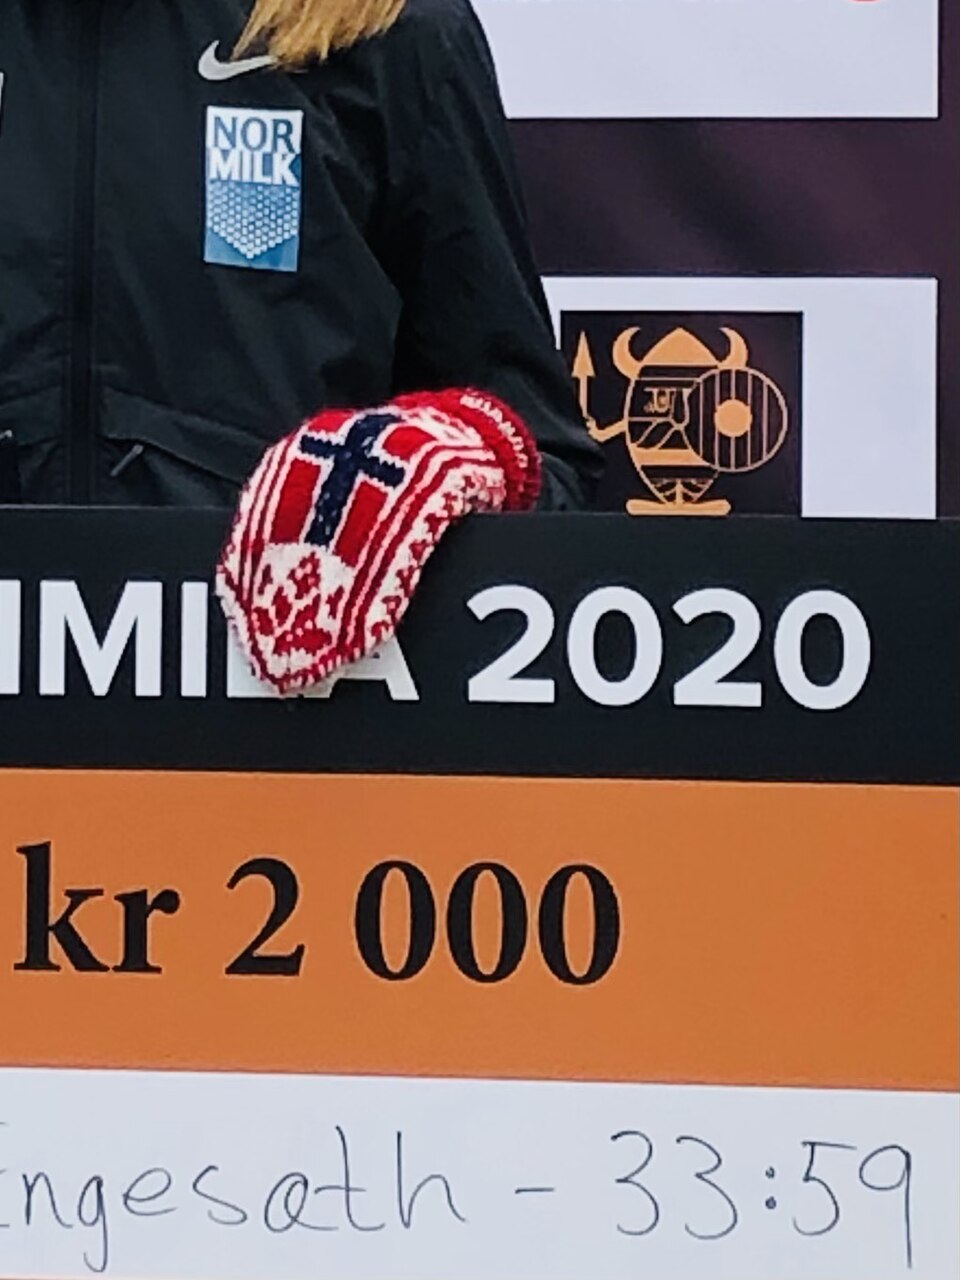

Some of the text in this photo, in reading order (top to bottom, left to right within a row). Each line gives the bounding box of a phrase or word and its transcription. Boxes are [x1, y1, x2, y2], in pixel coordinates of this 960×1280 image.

[209, 149, 301, 187] MILK
[213, 116, 296, 154] NOR
[466, 584, 871, 710] 2020
[13, 840, 181, 974] kr
[224, 857, 306, 977] 2
[354, 860, 621, 986] 000
[609, 1129, 913, 1270] 33:59
